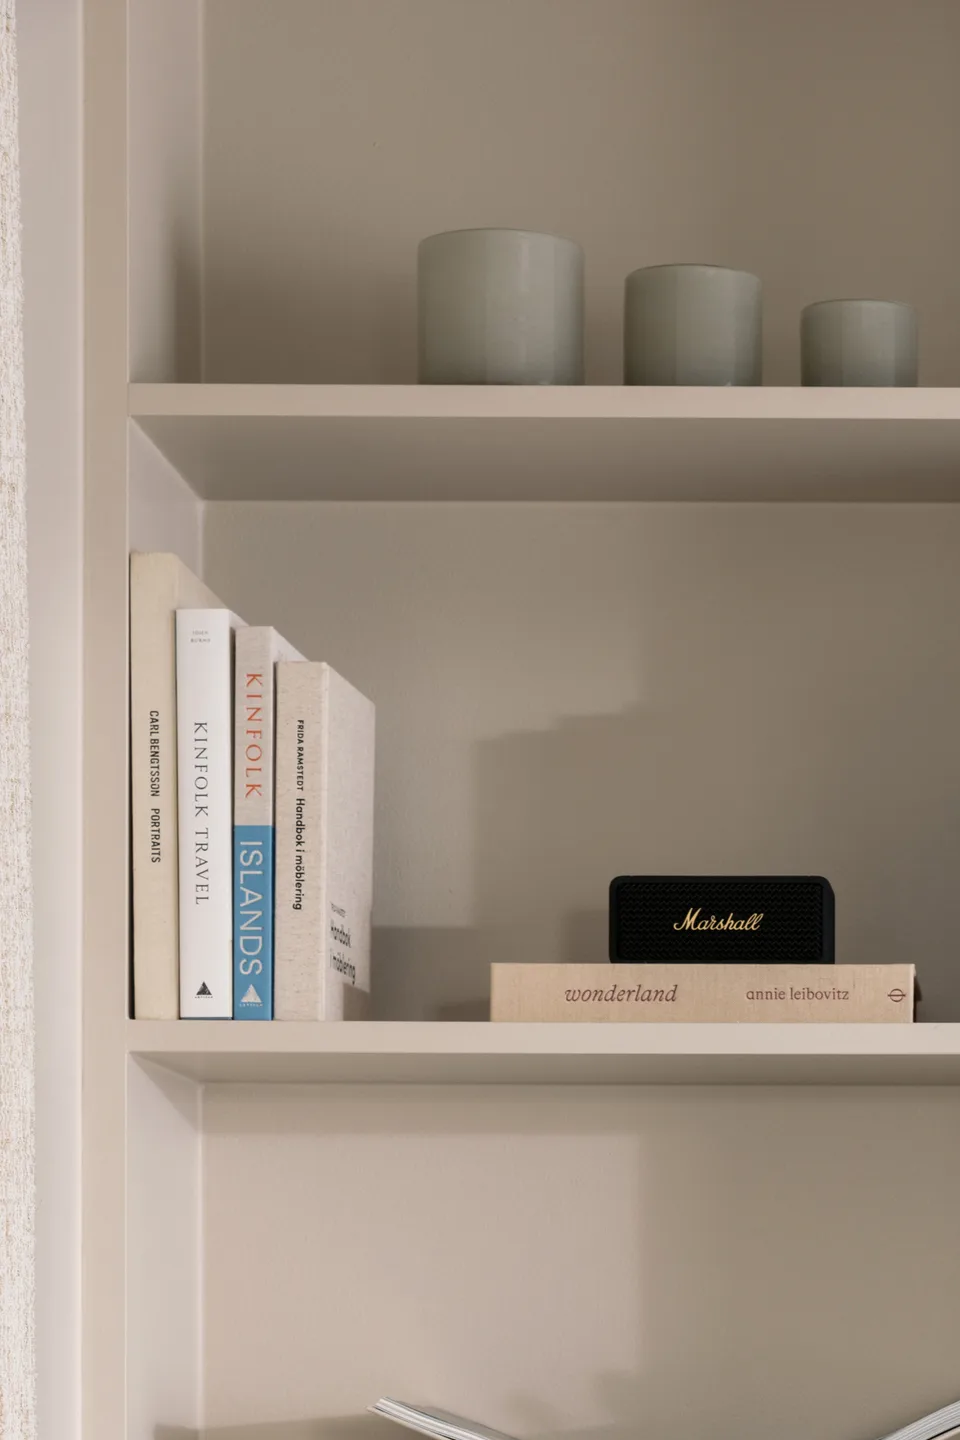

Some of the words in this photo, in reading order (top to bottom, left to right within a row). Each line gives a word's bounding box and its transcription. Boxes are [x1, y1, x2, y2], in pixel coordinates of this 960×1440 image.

[149, 710, 160, 736] CARL
[244, 673, 264, 798] KINFOLK
[296, 720, 305, 745] FRIDA
[150, 739, 161, 797] BENGTSSON
[194, 722, 209, 818] KINFOLK
[296, 746, 305, 792] RAMSTEDT
[150, 808, 162, 863] PORTRAITS
[295, 798, 306, 846] Handbok
[194, 828, 210, 906] TRAVEL
[292, 855, 306, 911] möblering
[238, 841, 264, 976] ISLANDS
[673, 907, 765, 932] Marshall
[564, 984, 679, 1004] wonderland
[746, 987, 787, 1001] annie
[789, 986, 850, 1001] leibovitz
